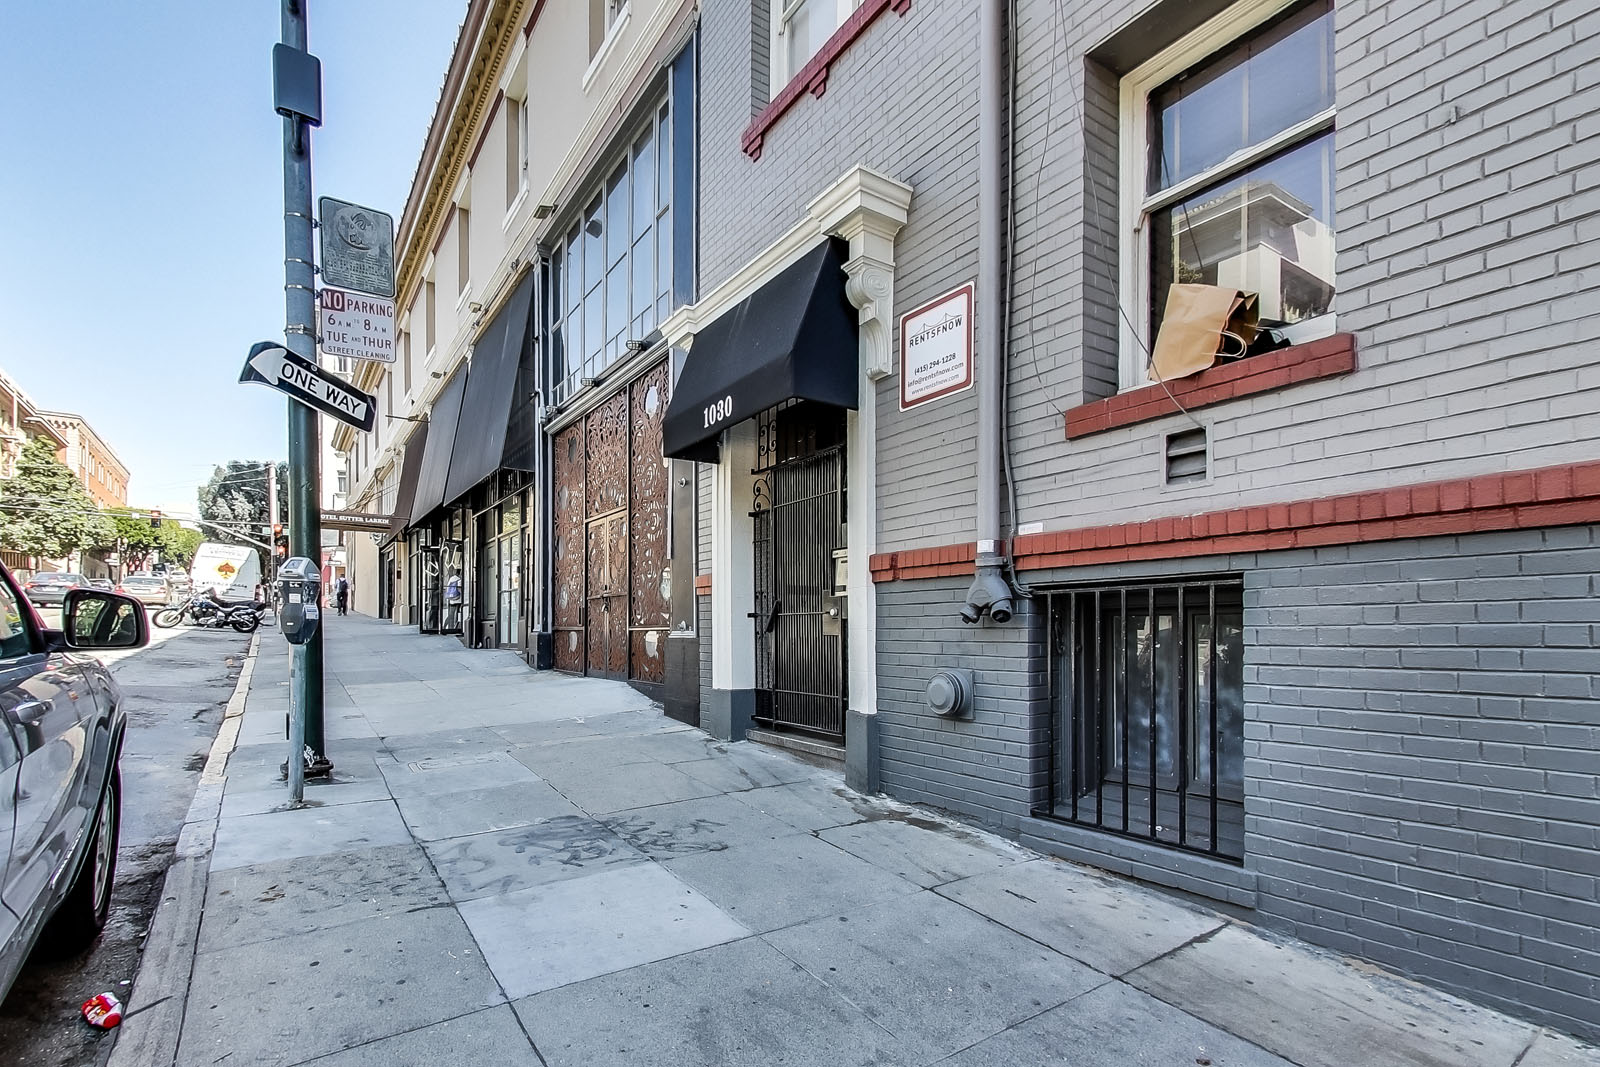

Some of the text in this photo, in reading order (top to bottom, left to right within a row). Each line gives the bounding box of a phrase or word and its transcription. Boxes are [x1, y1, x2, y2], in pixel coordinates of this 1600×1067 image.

[322, 290, 393, 318] NO PARKING
[327, 313, 336, 326] 6
[363, 318, 371, 331] 8
[908, 316, 963, 348] RENTSFNOW
[326, 330, 348, 344] TUE
[362, 335, 392, 350] THUR
[327, 345, 391, 361] STREET CLEANING
[914, 352, 957, 376] (415) 294-1228
[907, 361, 965, 388] info@rentsfnow.com
[911, 373, 960, 395] www.rentsfnow.com
[281, 362, 361, 415] ONE WAY
[703, 395, 733, 429] 1030
